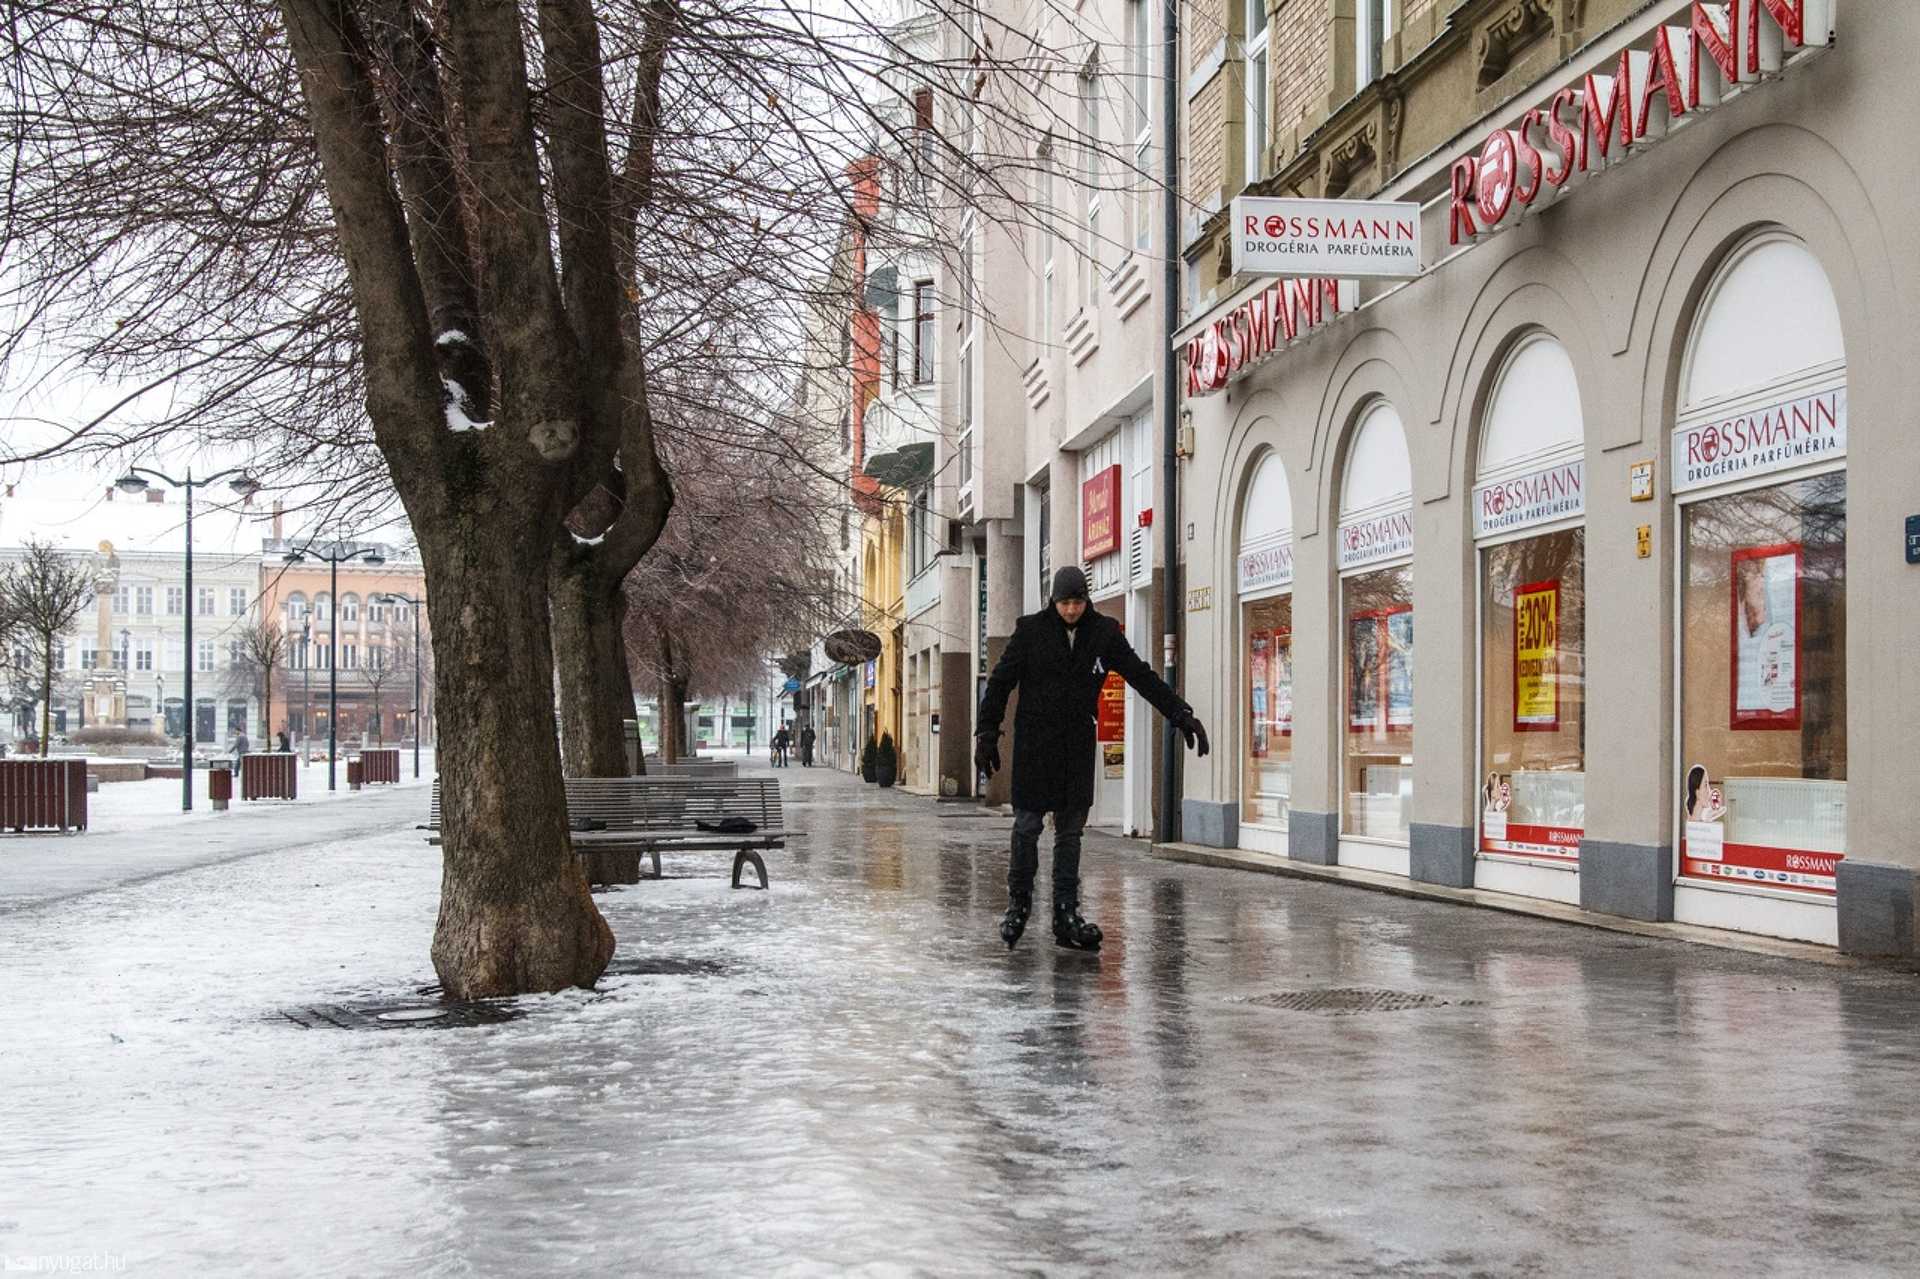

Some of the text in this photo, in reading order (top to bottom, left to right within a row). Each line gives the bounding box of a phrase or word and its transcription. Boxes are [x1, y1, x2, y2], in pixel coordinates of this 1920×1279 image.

[1245, 215, 1414, 241] ROSSMANN
[1245, 240, 1414, 257] DROGÉRIA PARFÜMÉRIA
[1687, 393, 1836, 466] ROSSMANN
[1688, 457, 1748, 482] DROGÉRIA
[1483, 463, 1580, 518] ROSSMANN
[1344, 511, 1412, 551] ROSSMANN
[1525, 594, 1554, 650] 20%
